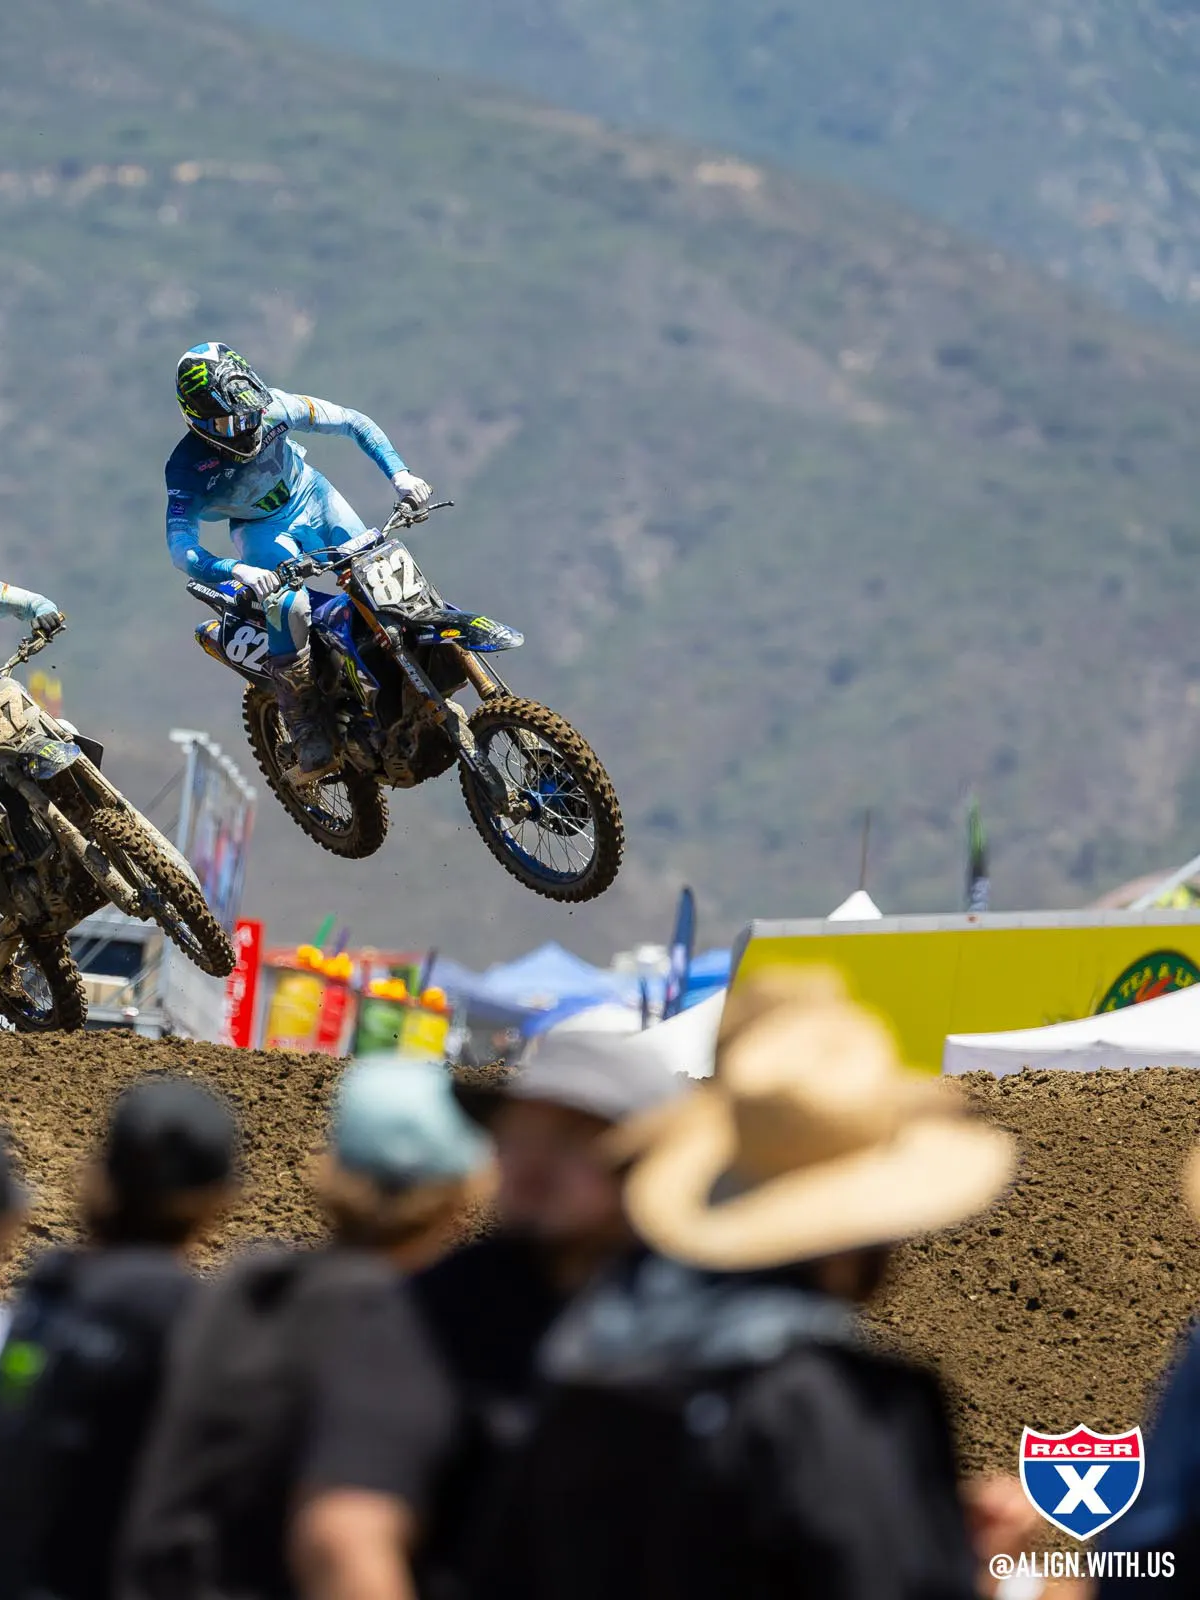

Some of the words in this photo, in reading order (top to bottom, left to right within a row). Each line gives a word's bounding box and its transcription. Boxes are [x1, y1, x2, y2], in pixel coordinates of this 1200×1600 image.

[193, 583, 221, 599] DUNLOP
[366, 549, 425, 606] 82
[226, 625, 270, 672] 82
